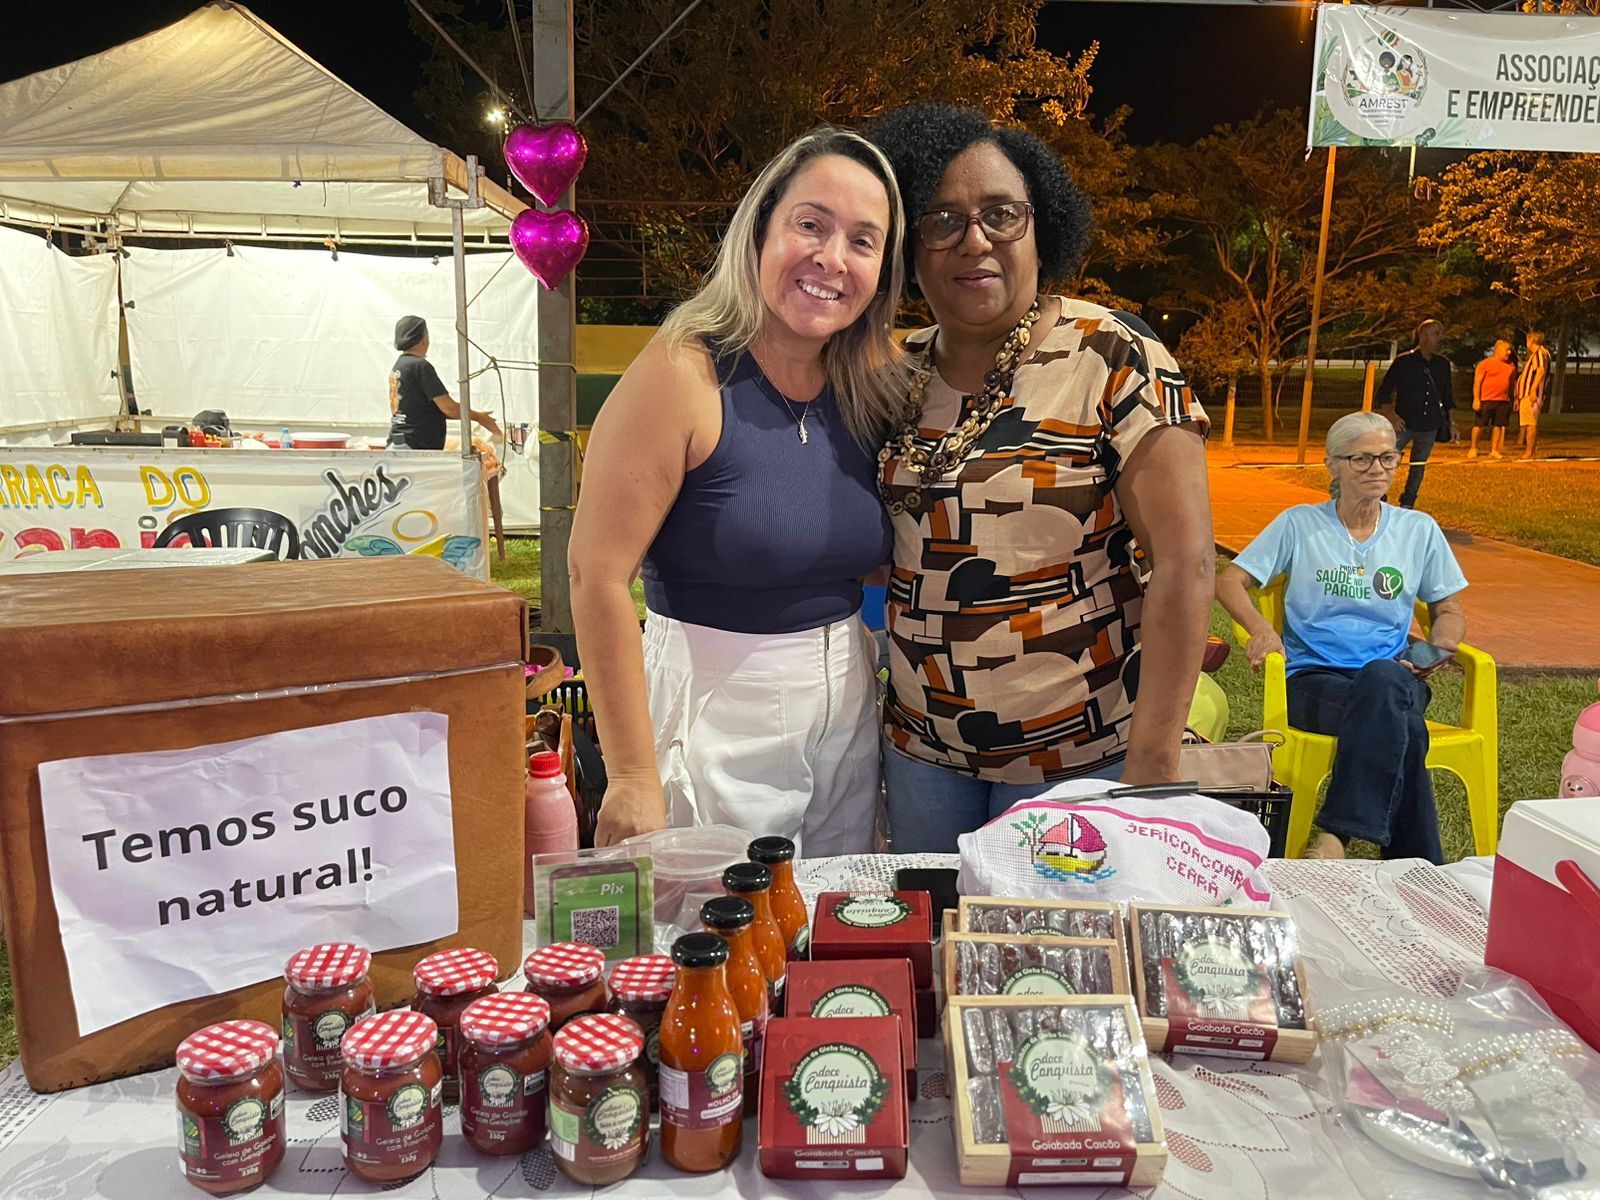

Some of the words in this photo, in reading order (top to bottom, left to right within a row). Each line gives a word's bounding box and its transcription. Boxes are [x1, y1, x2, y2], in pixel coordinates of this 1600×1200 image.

[1496, 53, 1600, 91] ASSOCIAÇ
[1359, 98, 1408, 109] AMREST
[1447, 89, 1461, 118] E
[1466, 90, 1600, 123] EMPREENDE
[140, 464, 211, 512] DO
[300, 466, 410, 560] anches
[1316, 567, 1352, 584] SAÚDE
[1353, 578, 1363, 587] NO
[1324, 583, 1372, 600] PARQUE
[82, 811, 276, 870] Temos
[293, 786, 408, 831] suco
[158, 847, 373, 926] natural!
[600, 883, 625, 896] Pix
[1191, 961, 1245, 978] Conquista
[853, 986, 870, 995] Santa
[832, 1004, 854, 1015] doce
[1188, 1021, 1231, 1034] Goiabada
[819, 1045, 838, 1053] Gleba
[839, 1045, 858, 1055] Santa
[1038, 1052, 1063, 1064] doce
[814, 1064, 840, 1077] doce
[1030, 1062, 1094, 1081] Conquista
[804, 1073, 868, 1093] Conquista
[1031, 1139, 1082, 1151] Goiabada
[213, 1151, 240, 1160] Geleia
[794, 1149, 844, 1157] Goiabada
